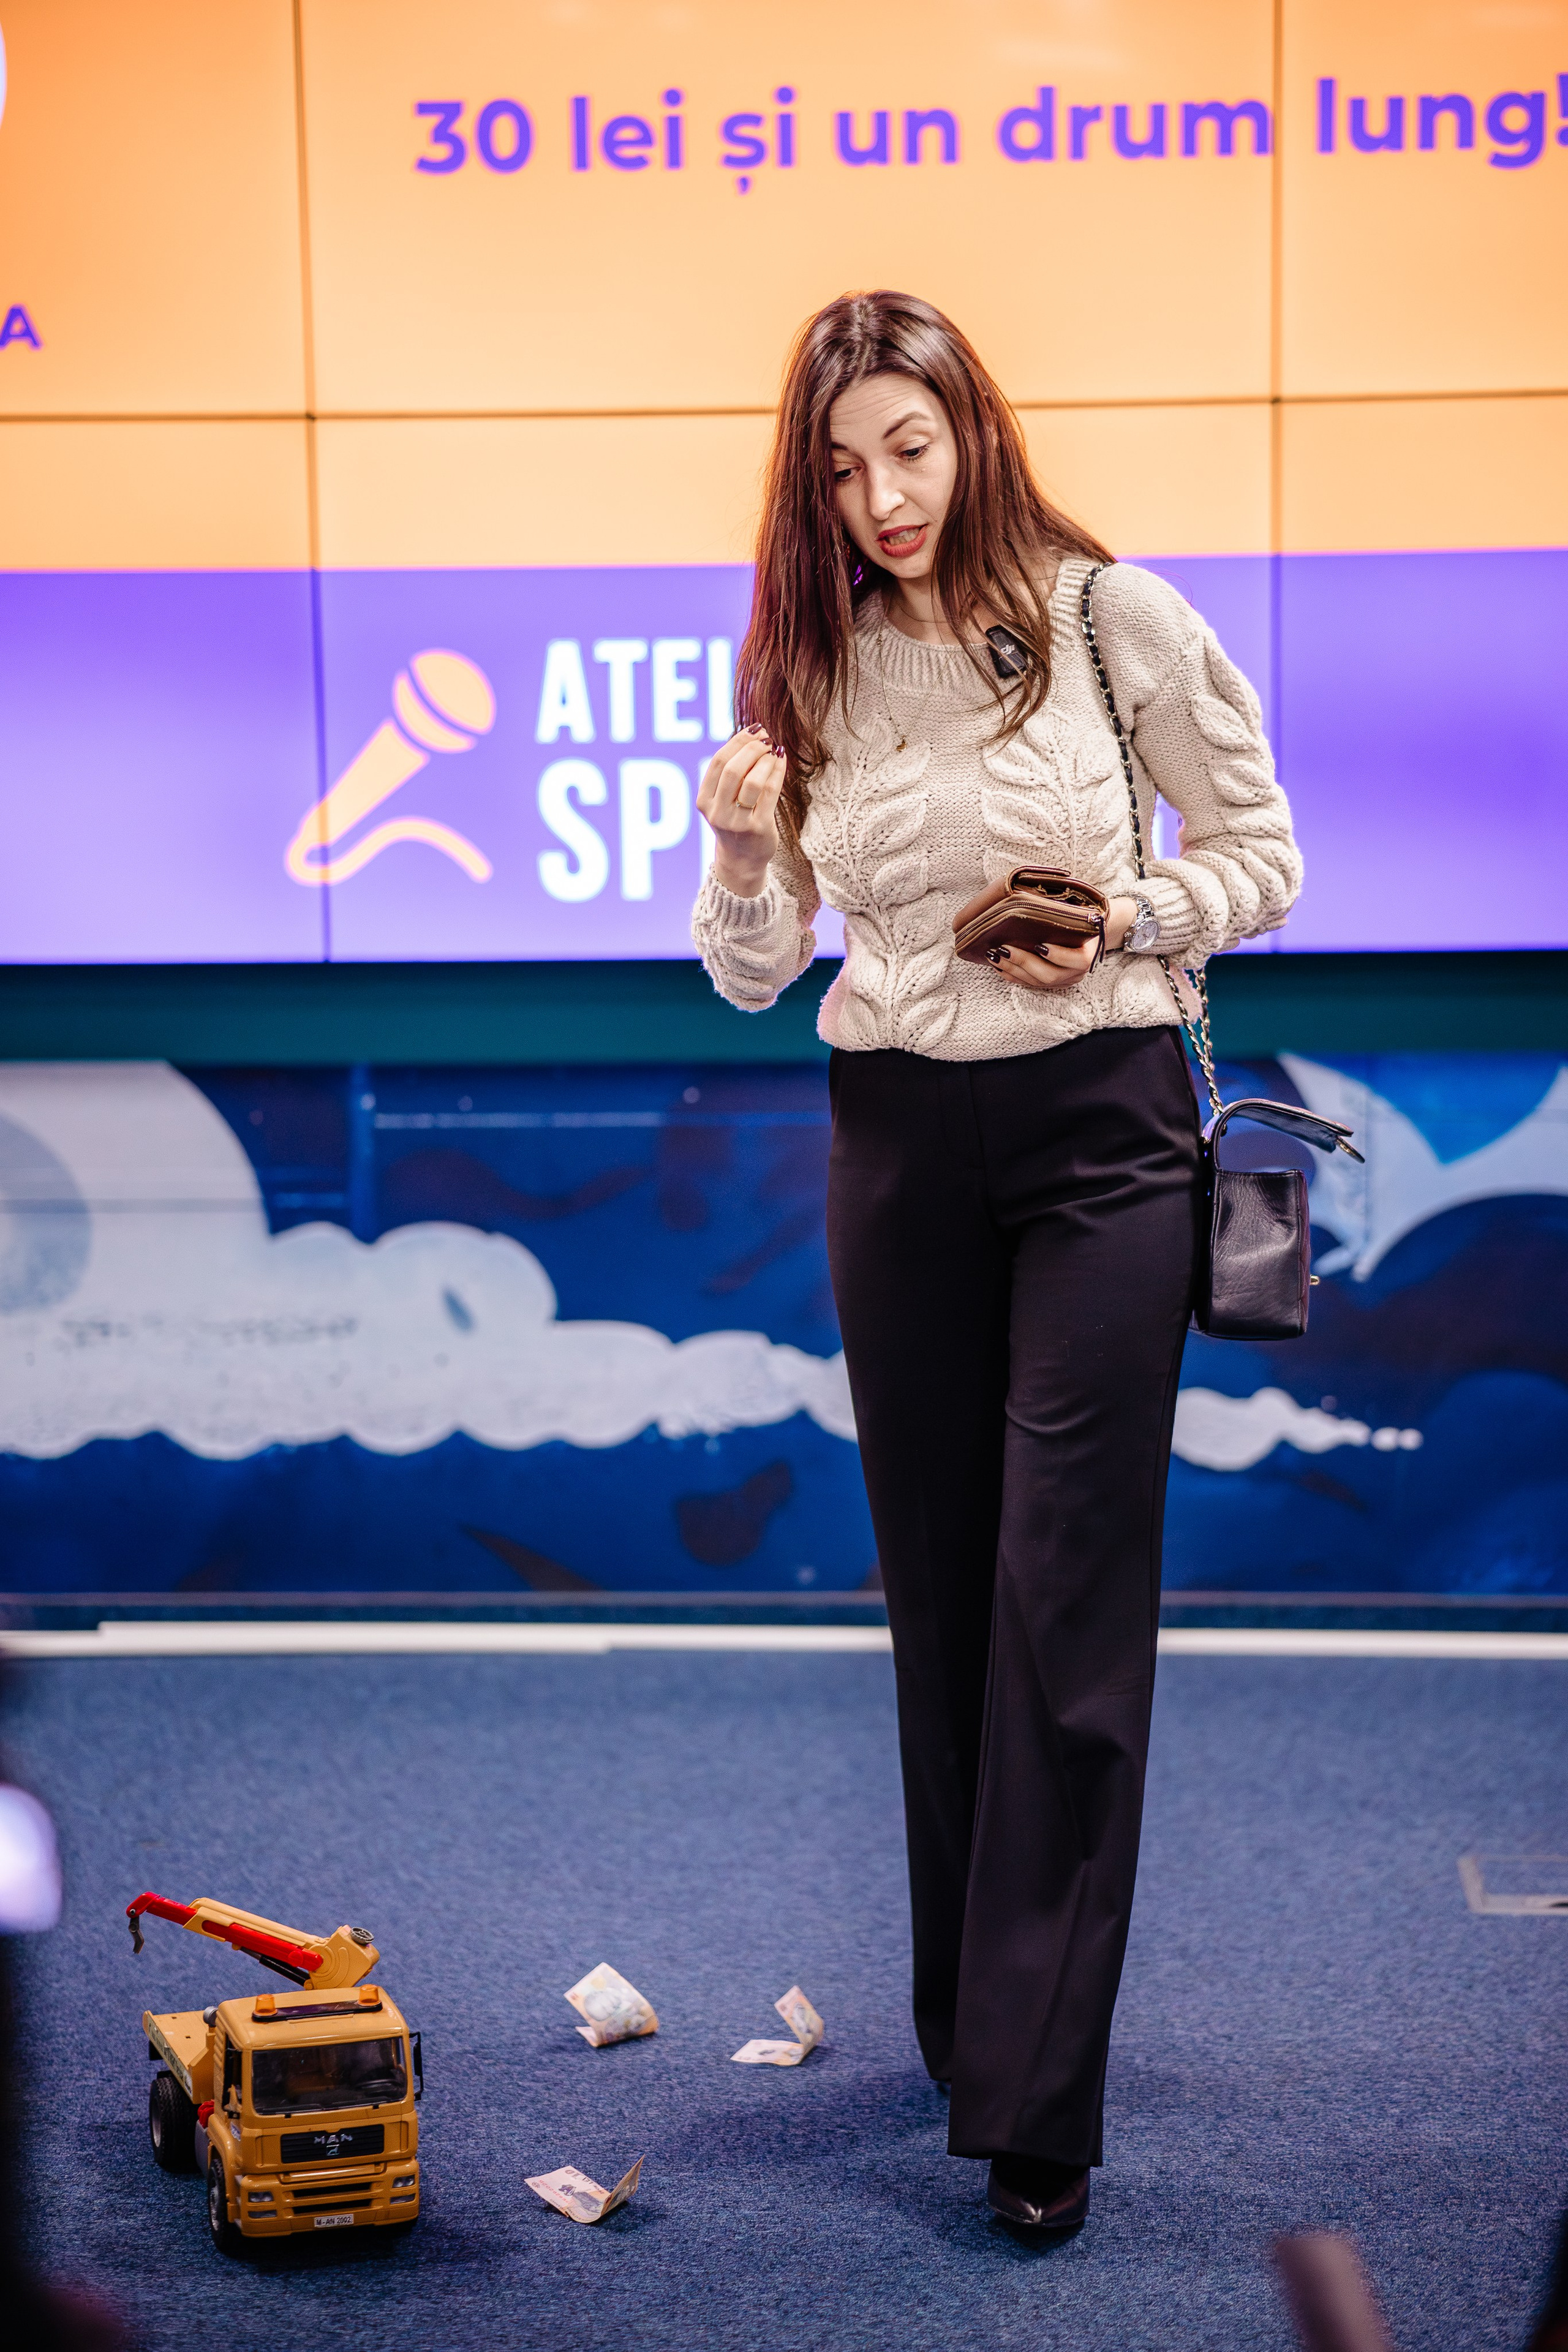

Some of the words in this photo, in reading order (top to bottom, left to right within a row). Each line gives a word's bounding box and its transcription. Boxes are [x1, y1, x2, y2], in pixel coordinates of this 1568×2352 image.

[417, 98, 532, 173] 30
[573, 88, 682, 170] lei
[722, 86, 794, 192] și
[837, 108, 957, 165] un
[998, 86, 1271, 162] drum
[1318, 71, 1568, 169] lung!
[537, 758, 717, 903] SP
[314, 2133, 353, 2144] MAN
